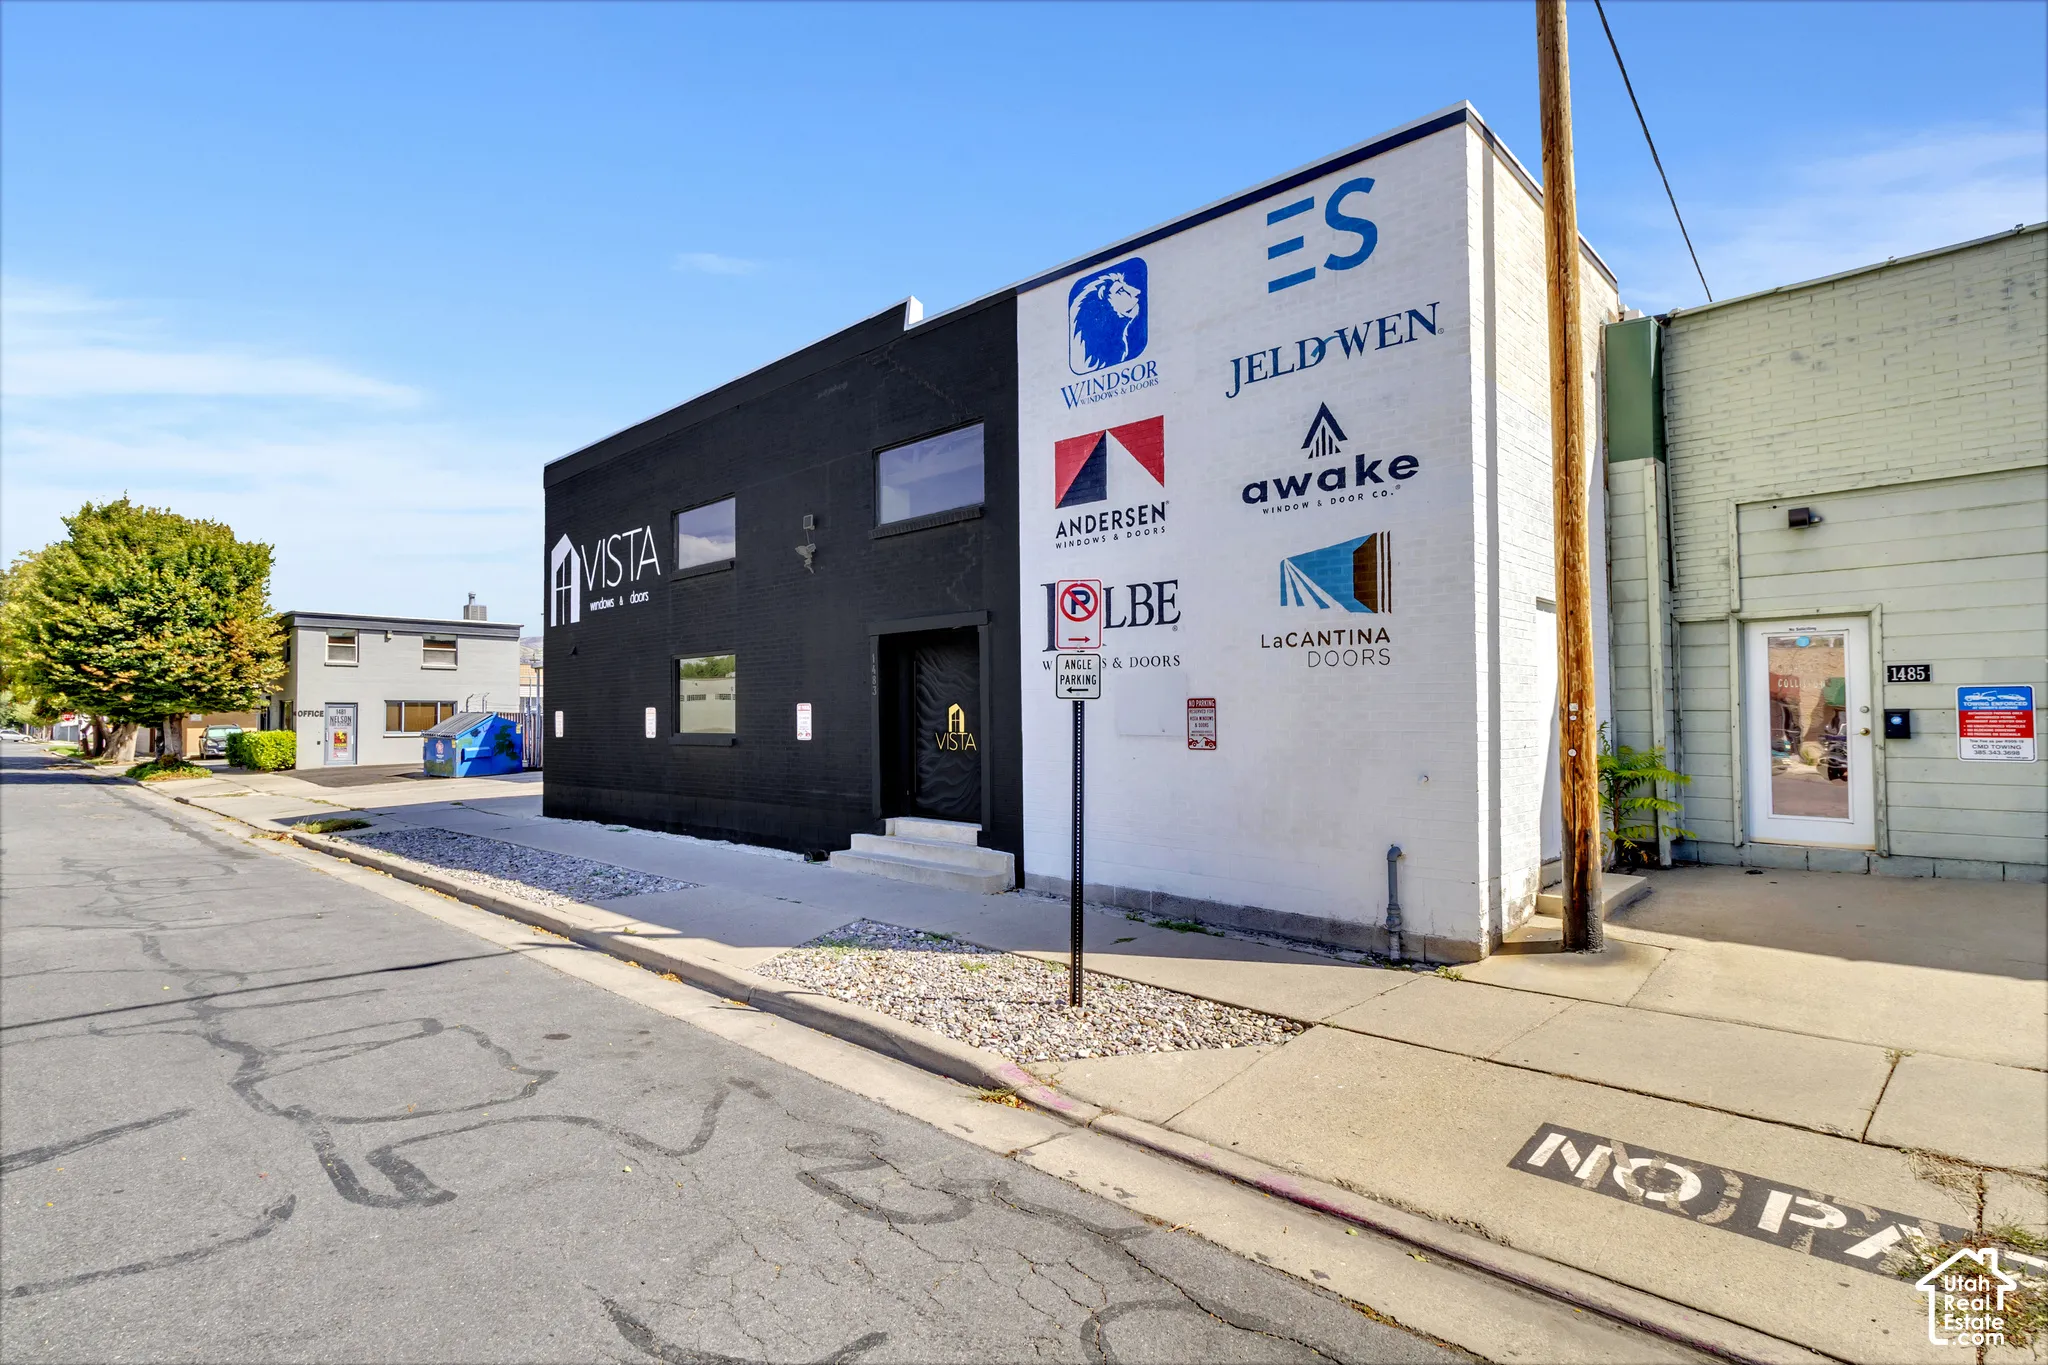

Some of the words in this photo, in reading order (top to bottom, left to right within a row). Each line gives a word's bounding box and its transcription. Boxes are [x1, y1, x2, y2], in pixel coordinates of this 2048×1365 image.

[1061, 361, 1158, 410] WINDSOR
[1080, 389, 1119, 406] WINDOWS
[1129, 378, 1159, 393] DOORS
[1242, 453, 1419, 504] awake
[1262, 501, 1310, 515] WINDOW
[1330, 493, 1364, 505] DOOR
[1372, 489, 1394, 499] CO.
[1055, 501, 1166, 539] ANDERSEN
[1055, 535, 1106, 550] WINDOWS
[1113, 533, 1119, 541] &
[1126, 526, 1166, 539] DOORS
[581, 525, 661, 591] VISTA
[589, 597, 614, 611] windows
[629, 590, 649, 604] doors
[1261, 627, 1391, 648] LaCANTINA
[1064, 659, 1092, 670] ANGLE
[1112, 657, 1123, 669] &
[1129, 655, 1181, 669] DOORS
[1308, 648, 1391, 667] DOORS
[1060, 674, 1097, 685] PARKING
[1890, 666, 1925, 681] 1485
[330, 715, 352, 723] NELSON
[935, 732, 977, 750] VISTA
[1527, 1132, 1702, 1202] NO
